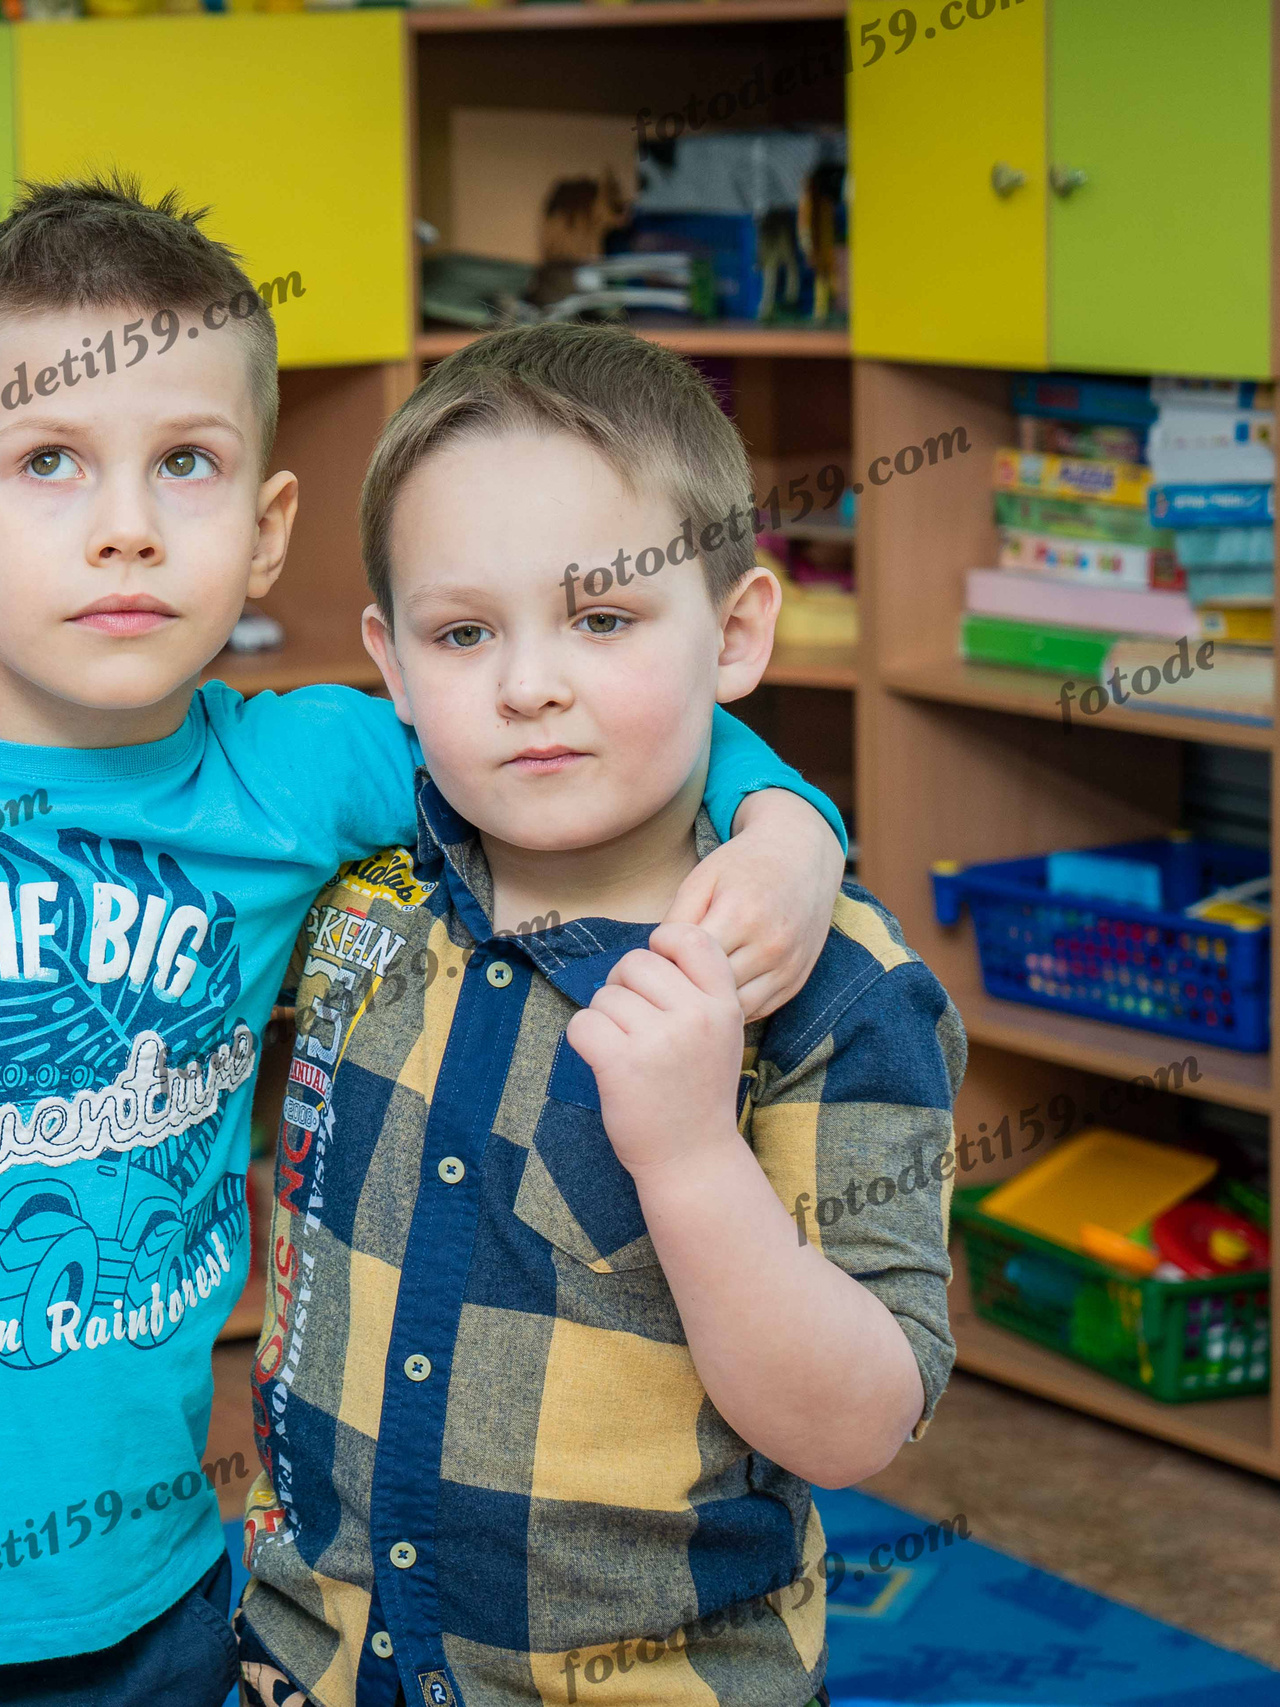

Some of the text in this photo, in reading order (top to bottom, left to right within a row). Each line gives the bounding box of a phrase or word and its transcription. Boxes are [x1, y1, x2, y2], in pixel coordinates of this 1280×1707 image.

[87, 881, 208, 1000] BIG
[46, 1230, 232, 1354] Rainforest
[272, 1249, 316, 1445] FASHION
